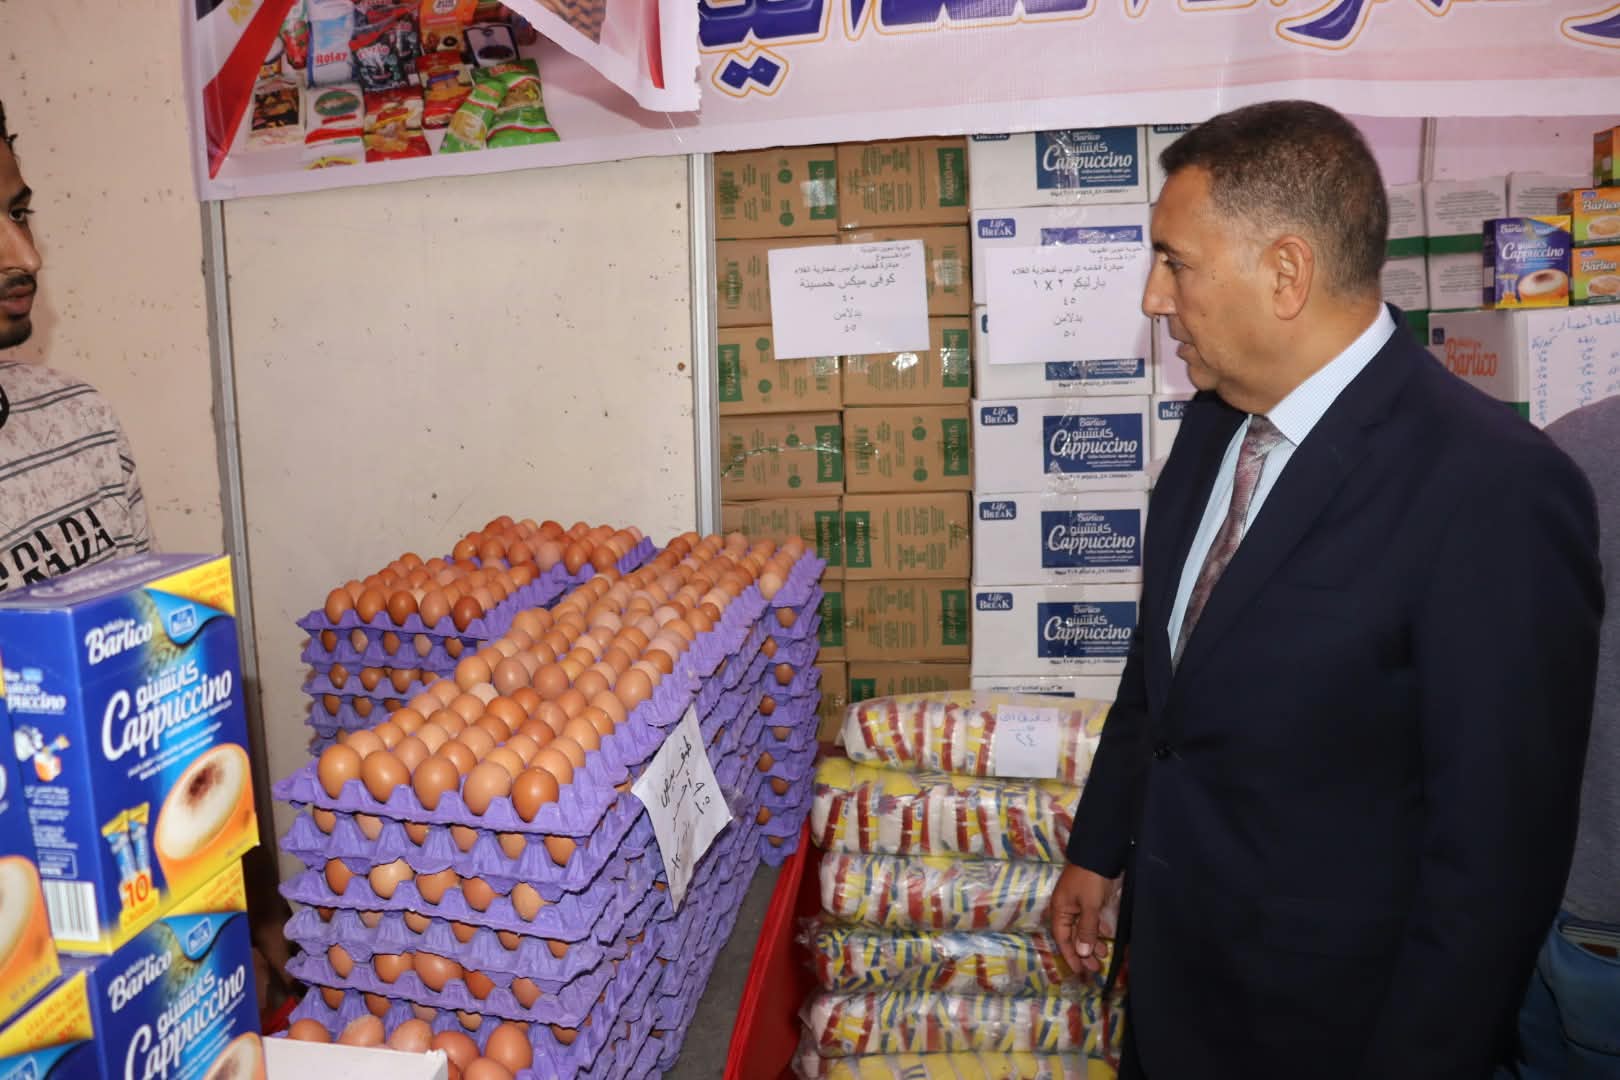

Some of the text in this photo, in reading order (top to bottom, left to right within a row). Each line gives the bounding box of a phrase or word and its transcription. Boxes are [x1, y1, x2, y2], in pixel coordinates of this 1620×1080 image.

[1042, 144, 1133, 176] Cappuccino
[1502, 244, 1564, 261] Cappuccino
[838, 276, 866, 289] ميكس
[1445, 338, 1498, 376] Barlico
[984, 413, 1015, 424] BREAK
[992, 407, 1008, 416] Life
[1050, 429, 1138, 460] Cappuccino
[983, 508, 1013, 519] BREAK
[991, 502, 1007, 510] Life
[1048, 525, 1136, 556] Cappuccino
[980, 600, 1011, 609] BREAK
[85, 620, 153, 665] Barlico
[1044, 616, 1132, 646] Cappuccino
[102, 670, 232, 761] Cappuccino
[123, 873, 150, 908] 10
[107, 950, 172, 1013] Barlico
[125, 965, 246, 1080] Cappuccino
